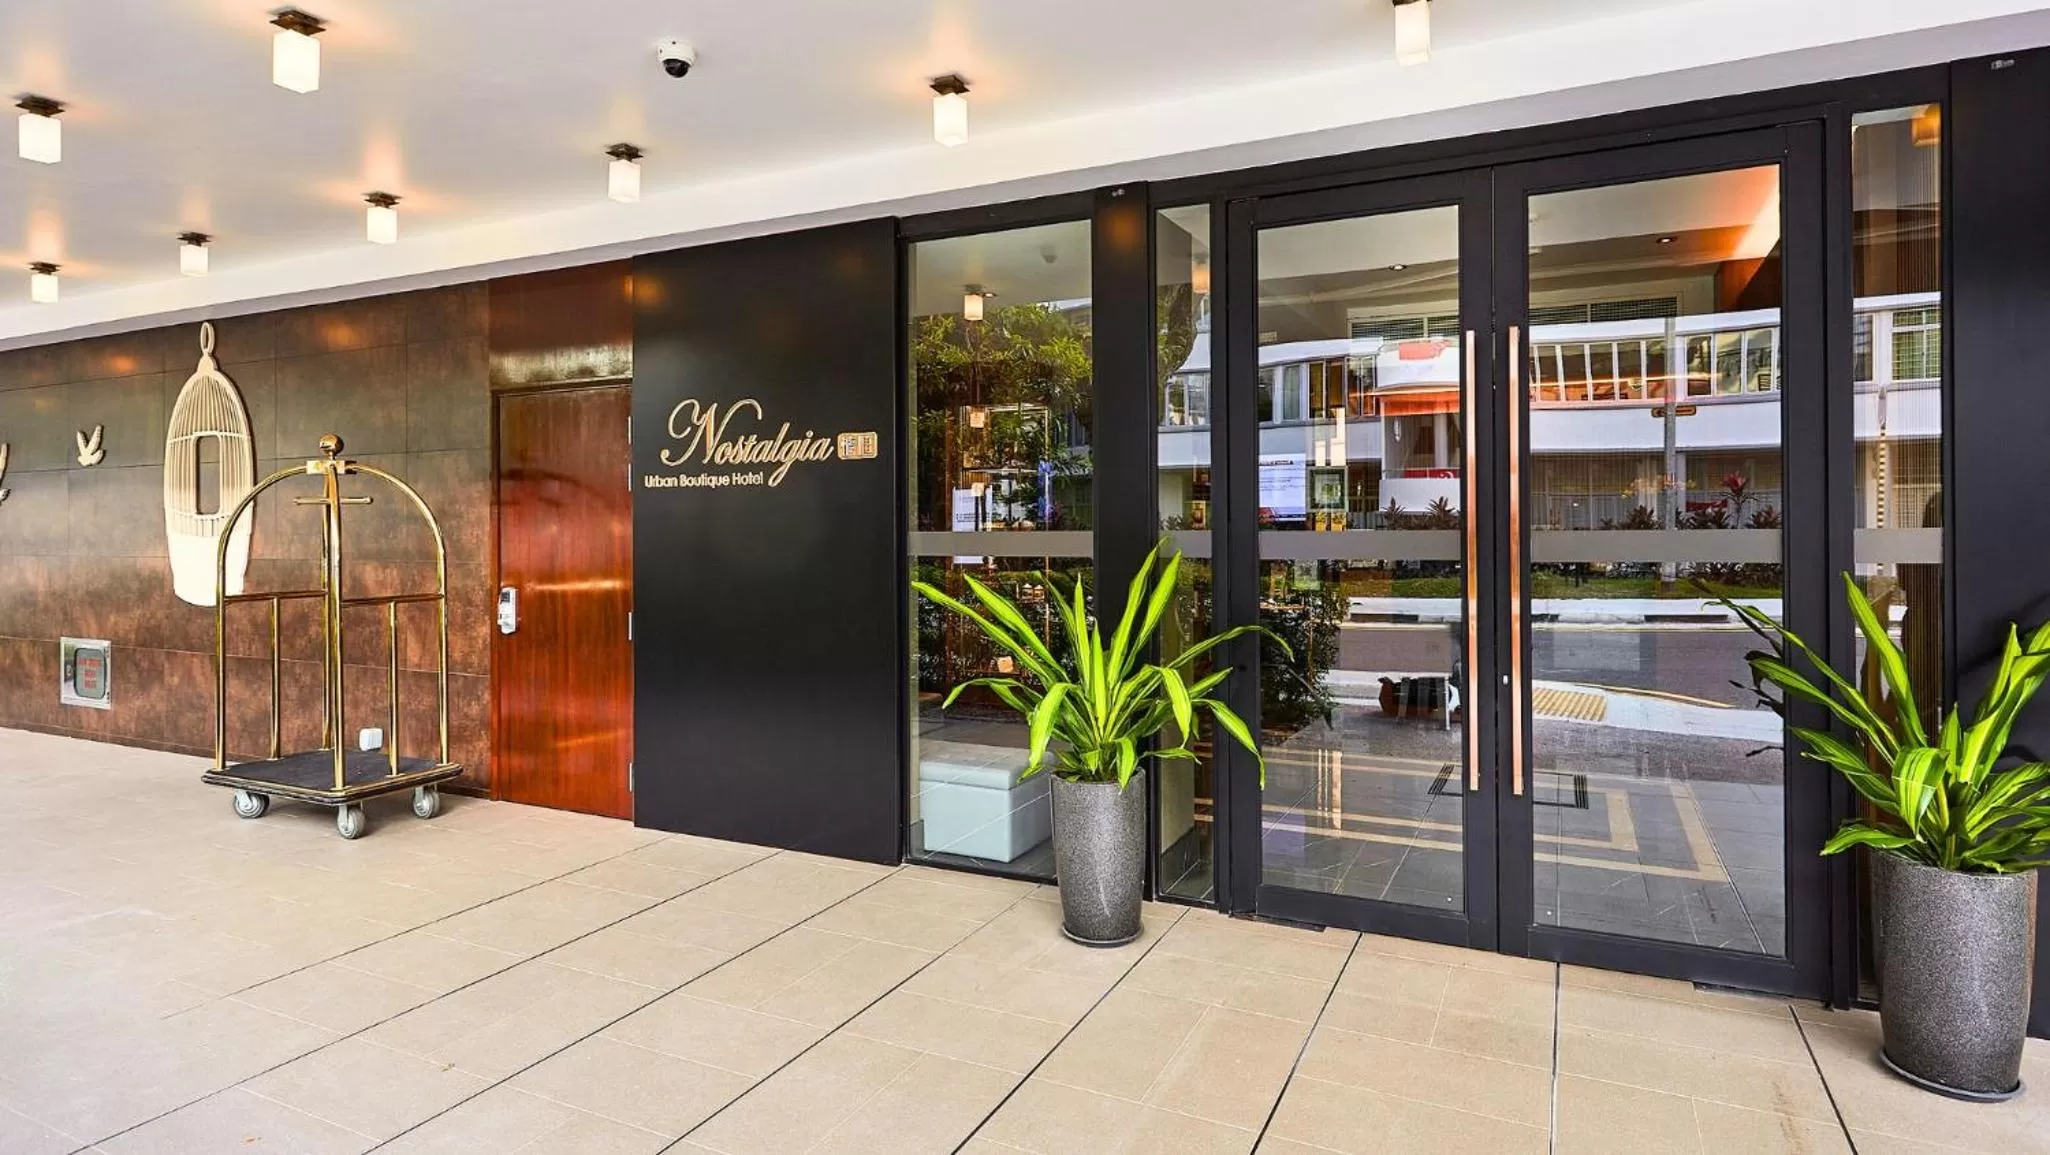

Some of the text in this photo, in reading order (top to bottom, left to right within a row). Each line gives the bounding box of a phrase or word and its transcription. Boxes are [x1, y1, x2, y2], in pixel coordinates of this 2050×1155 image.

[660, 399, 834, 487] Nostalgia
[644, 471, 764, 489] Urban Boutique Hotel
